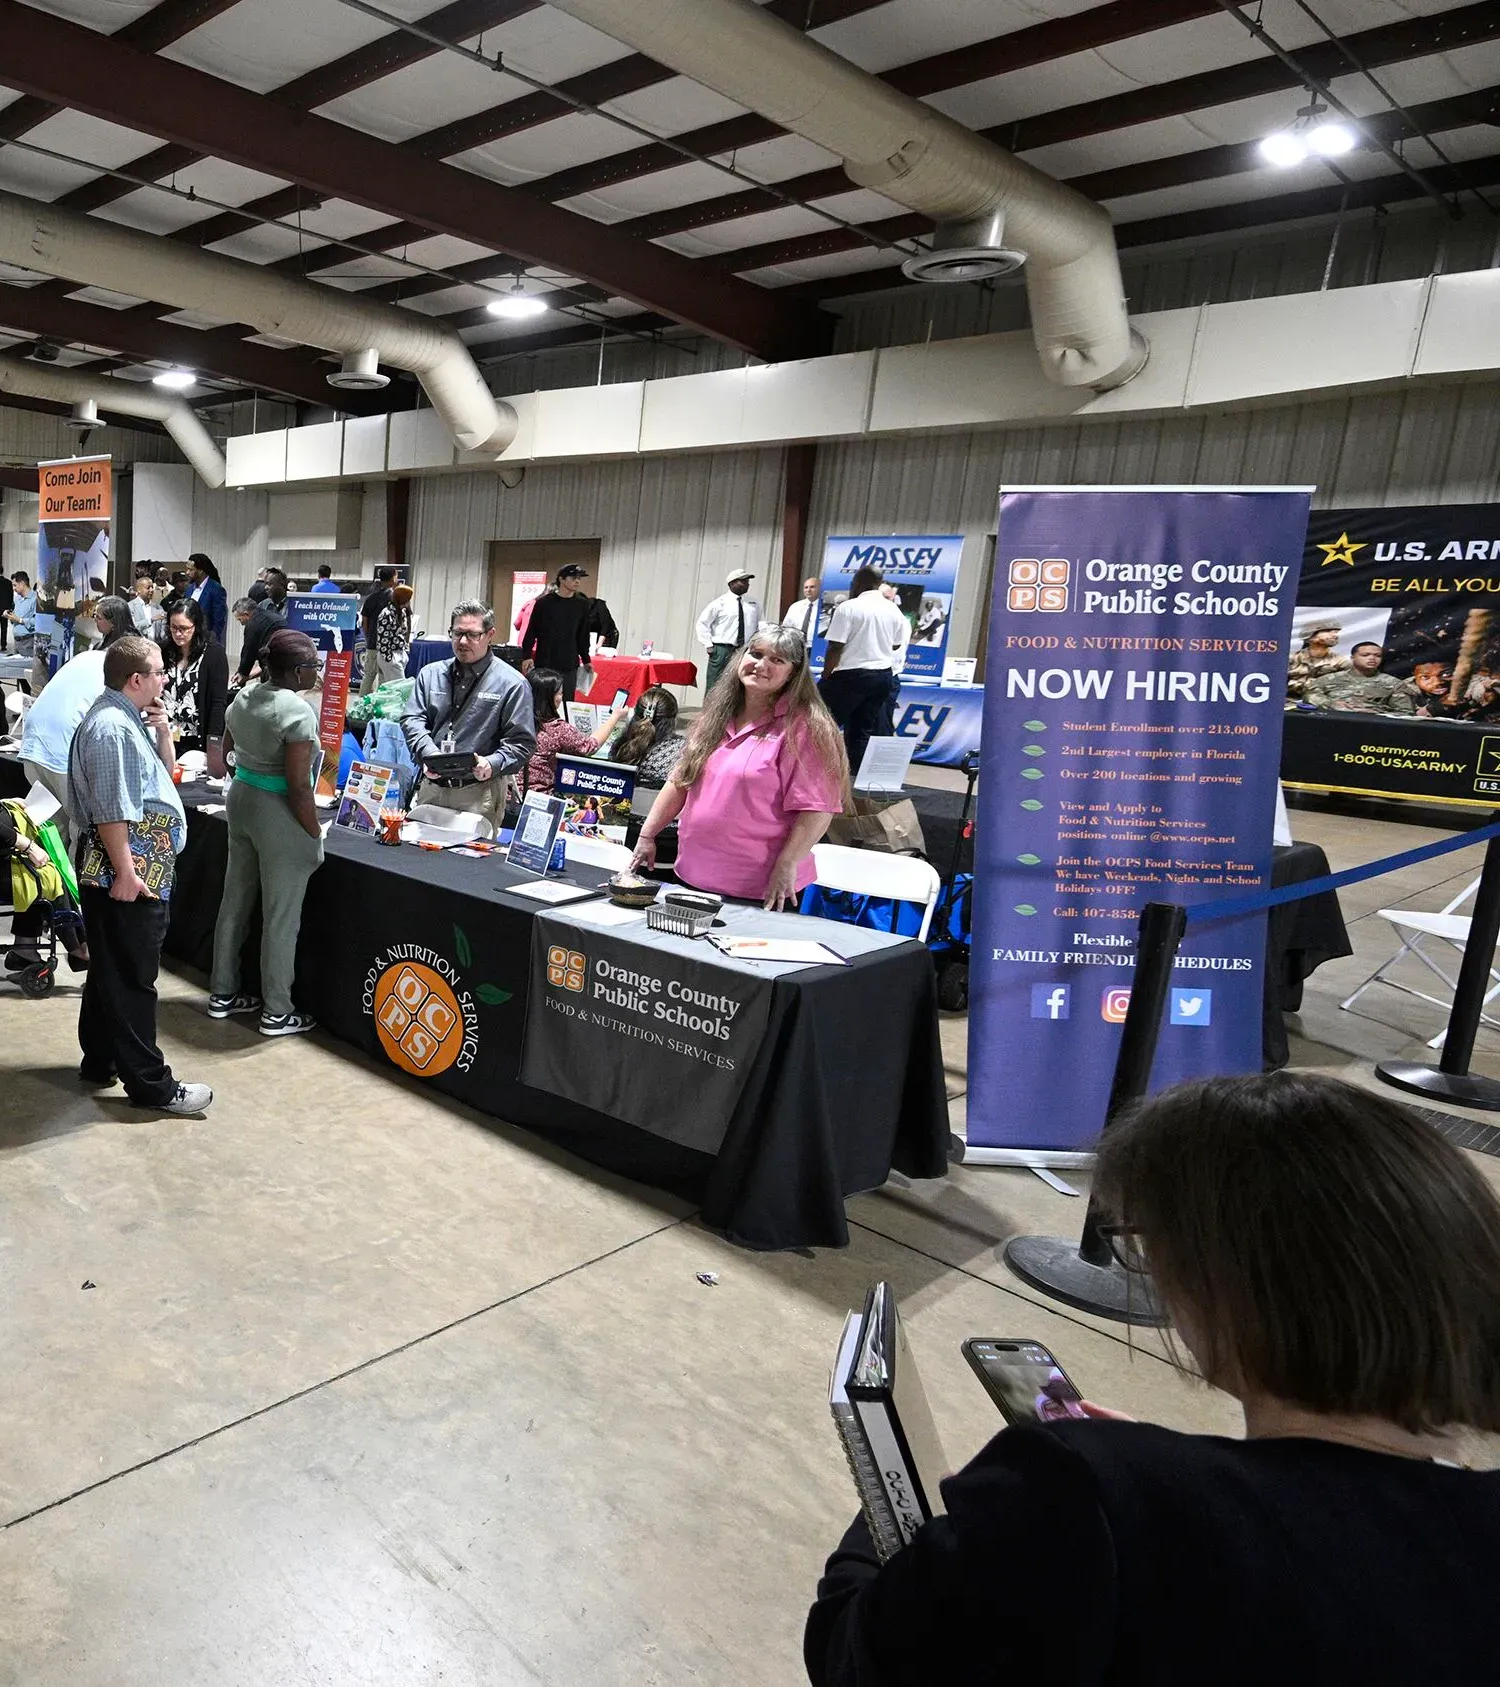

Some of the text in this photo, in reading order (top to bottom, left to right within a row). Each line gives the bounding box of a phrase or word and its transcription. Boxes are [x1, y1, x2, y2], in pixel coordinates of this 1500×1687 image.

[45, 467, 101, 488] Come Join
[45, 494, 101, 513] Our Team!
[843, 545, 942, 568] MASSEY
[1374, 540, 1432, 562] U.S.
[1086, 558, 1289, 592] Orange County
[1371, 578, 1500, 592] BE ALL YOU
[294, 600, 312, 610] Teach
[322, 602, 350, 612] Orlando
[1084, 590, 1279, 617] Public Schools
[303, 612, 337, 622] with OCPS
[1005, 635, 1278, 653] FOOD & NUTRITION SERVICES
[1007, 668, 1114, 700] NOW
[1126, 671, 1271, 704] HIRING
[1062, 721, 1259, 736] Student Enrollment over 213,000
[1061, 745, 1246, 761] 2nd Largest employer in Florida
[1360, 744, 1440, 759] goarmy.com
[1334, 754, 1467, 774] 1-800-USA-ARMY
[578, 771, 601, 782] Orange
[602, 776, 626, 788] County
[1061, 769, 1243, 785] Over 200 locations and growing
[577, 780, 622, 794] Public Schools
[1060, 801, 1162, 815] View and Apply to
[1059, 815, 1207, 829] Food & Nutrition Services
[1057, 830, 1236, 845] positions online @www.ocps.net
[1056, 855, 1254, 871] Join the OCPS Food Services Team
[1056, 870, 1261, 886] We have Weekends, Nights and School
[1055, 884, 1136, 896] Holidays OFF!
[1053, 907, 1140, 919] Call: 407-858-
[1073, 934, 1132, 947] Flexible
[992, 949, 1252, 970] FAMILY FRIENDL HEDULES
[596, 959, 740, 1022] Orange County
[362, 944, 478, 1072] FOOD & NUTRITION SERVICES
[594, 982, 730, 1041] Public Schools
[545, 996, 735, 1072] FOOD & NUTRITION SERVICES
